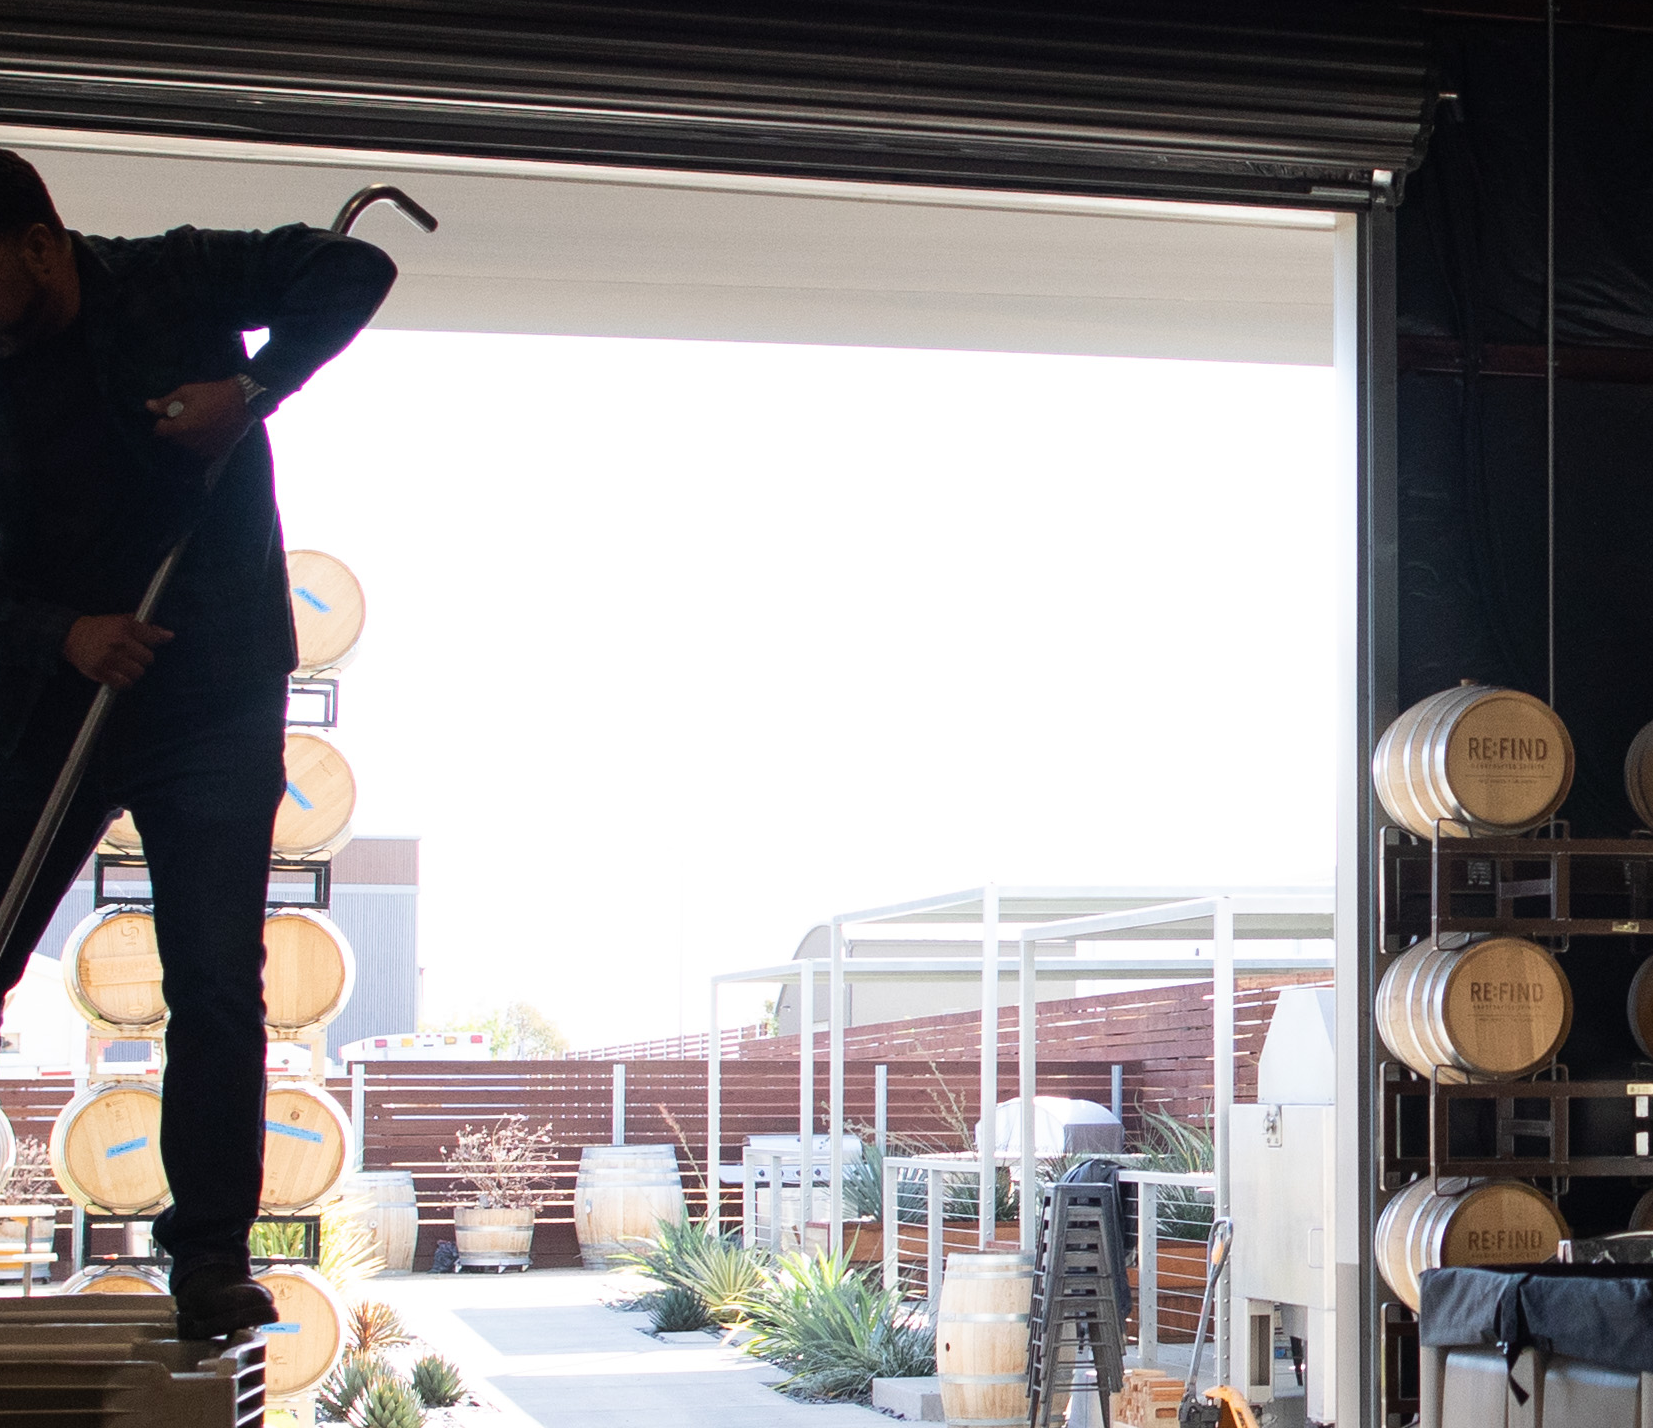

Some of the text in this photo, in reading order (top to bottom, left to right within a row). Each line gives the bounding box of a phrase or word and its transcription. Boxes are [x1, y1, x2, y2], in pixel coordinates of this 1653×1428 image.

[1468, 737, 1548, 760] RE:FIND
[1470, 982, 1544, 1003] RE:FIND
[1468, 1230, 1542, 1251] RE:FIND
